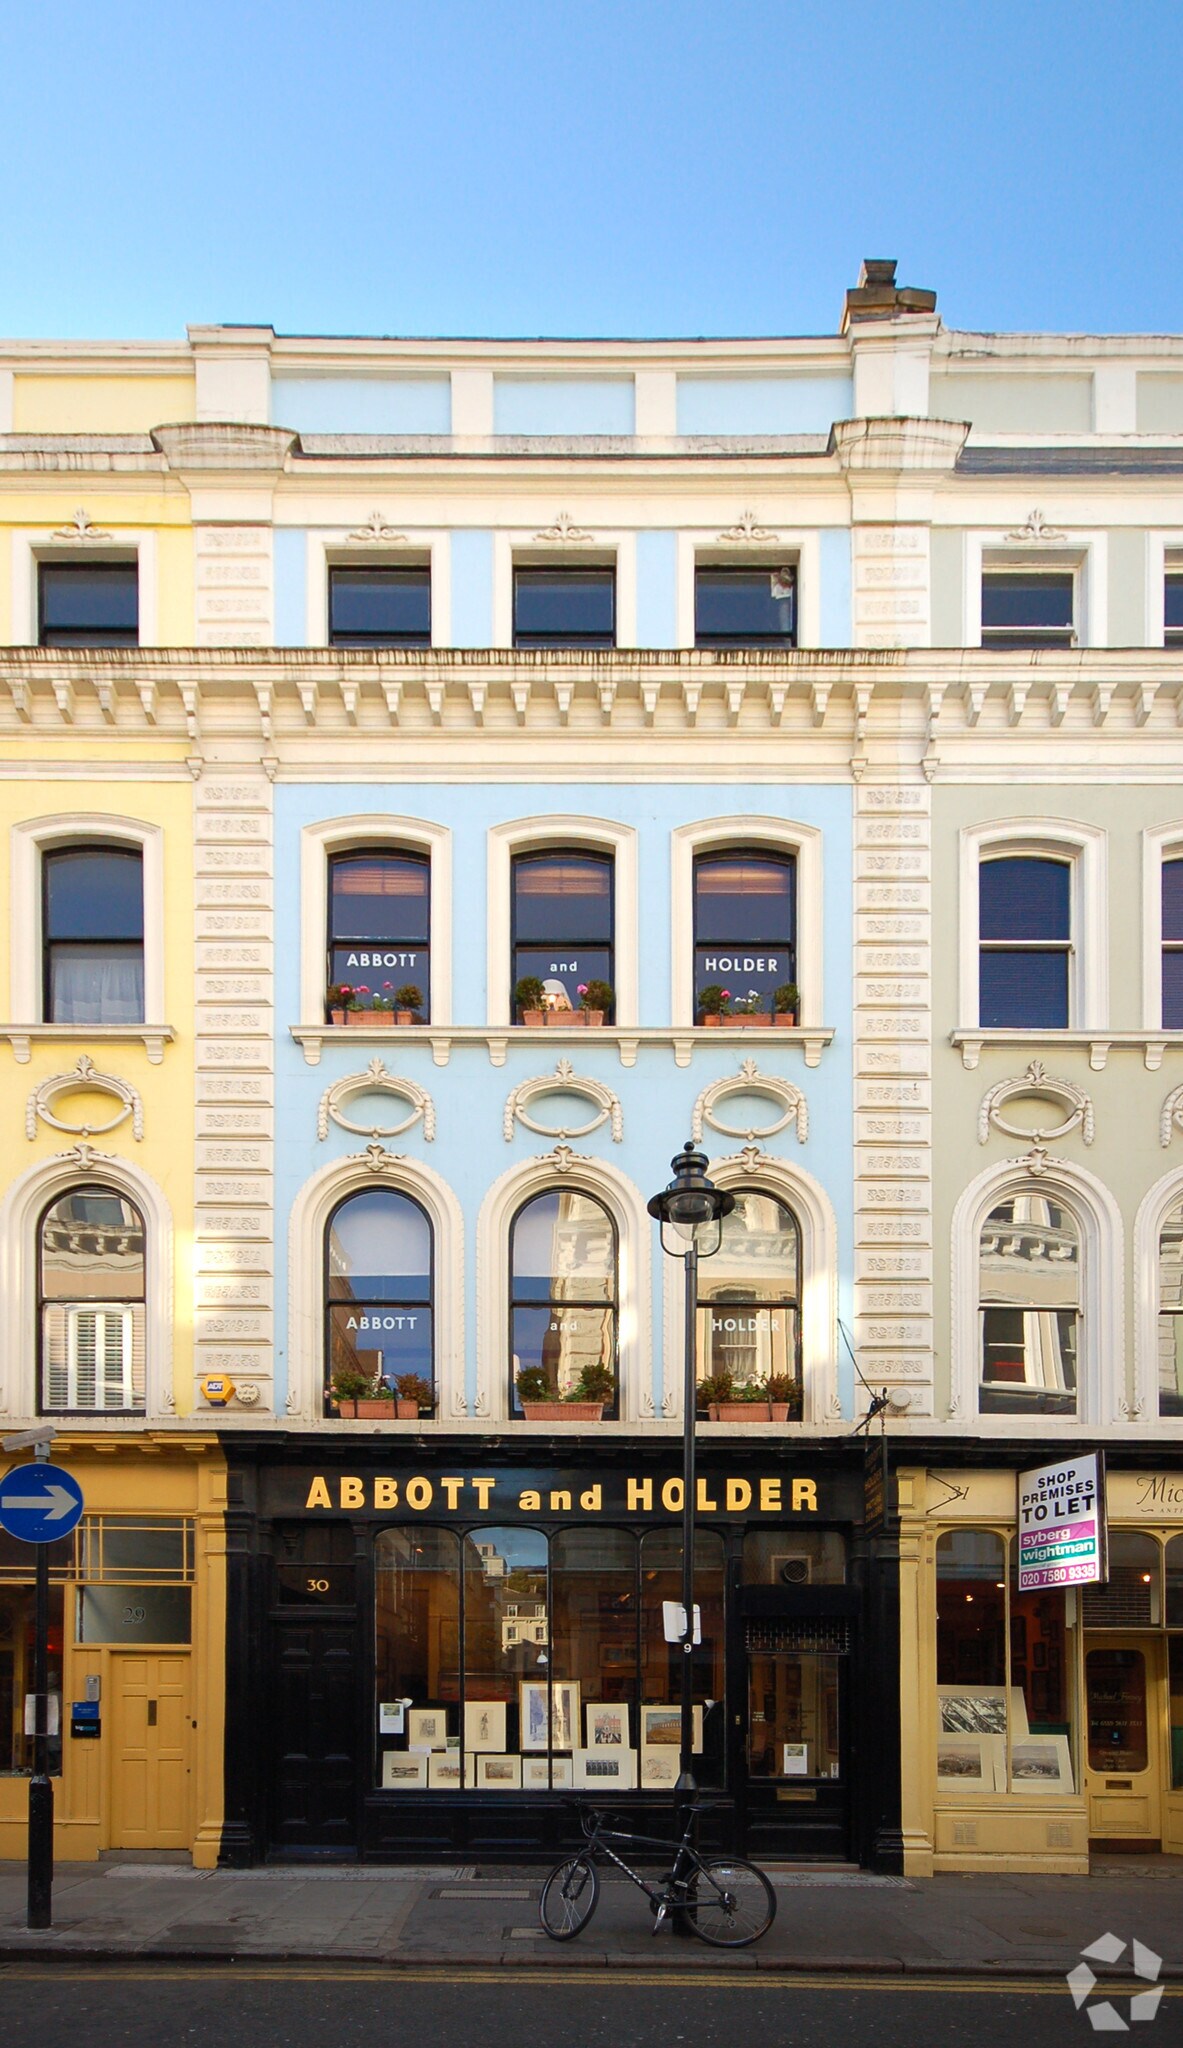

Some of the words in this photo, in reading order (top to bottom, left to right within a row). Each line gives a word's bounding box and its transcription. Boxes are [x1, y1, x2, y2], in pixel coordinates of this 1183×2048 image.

[346, 953, 417, 967] ABBOTT
[550, 960, 577, 972] and
[705, 957, 778, 972] HOLDER
[346, 1316, 418, 1330] ABBOTT
[550, 1320, 577, 1331] and
[711, 1318, 780, 1332] HOLDER
[1038, 1470, 1076, 1489] SHOP
[305, 1477, 496, 1511] ABBOTT
[519, 1484, 602, 1511] and
[627, 1477, 818, 1512] HOLDER
[1022, 1480, 1094, 1506] PREMISES
[1021, 1504, 1048, 1524] TO
[1054, 1494, 1095, 1518] LET
[1023, 1528, 1071, 1546] syberg
[1023, 1541, 1094, 1561] wightman
[1022, 1573, 1040, 1585] 020
[1042, 1568, 1067, 1583] 7580
[1068, 1564, 1095, 1580] 9335
[307, 1579, 329, 1592] 30
[122, 1607, 145, 1624] 29
[683, 1643, 692, 1653] 9
